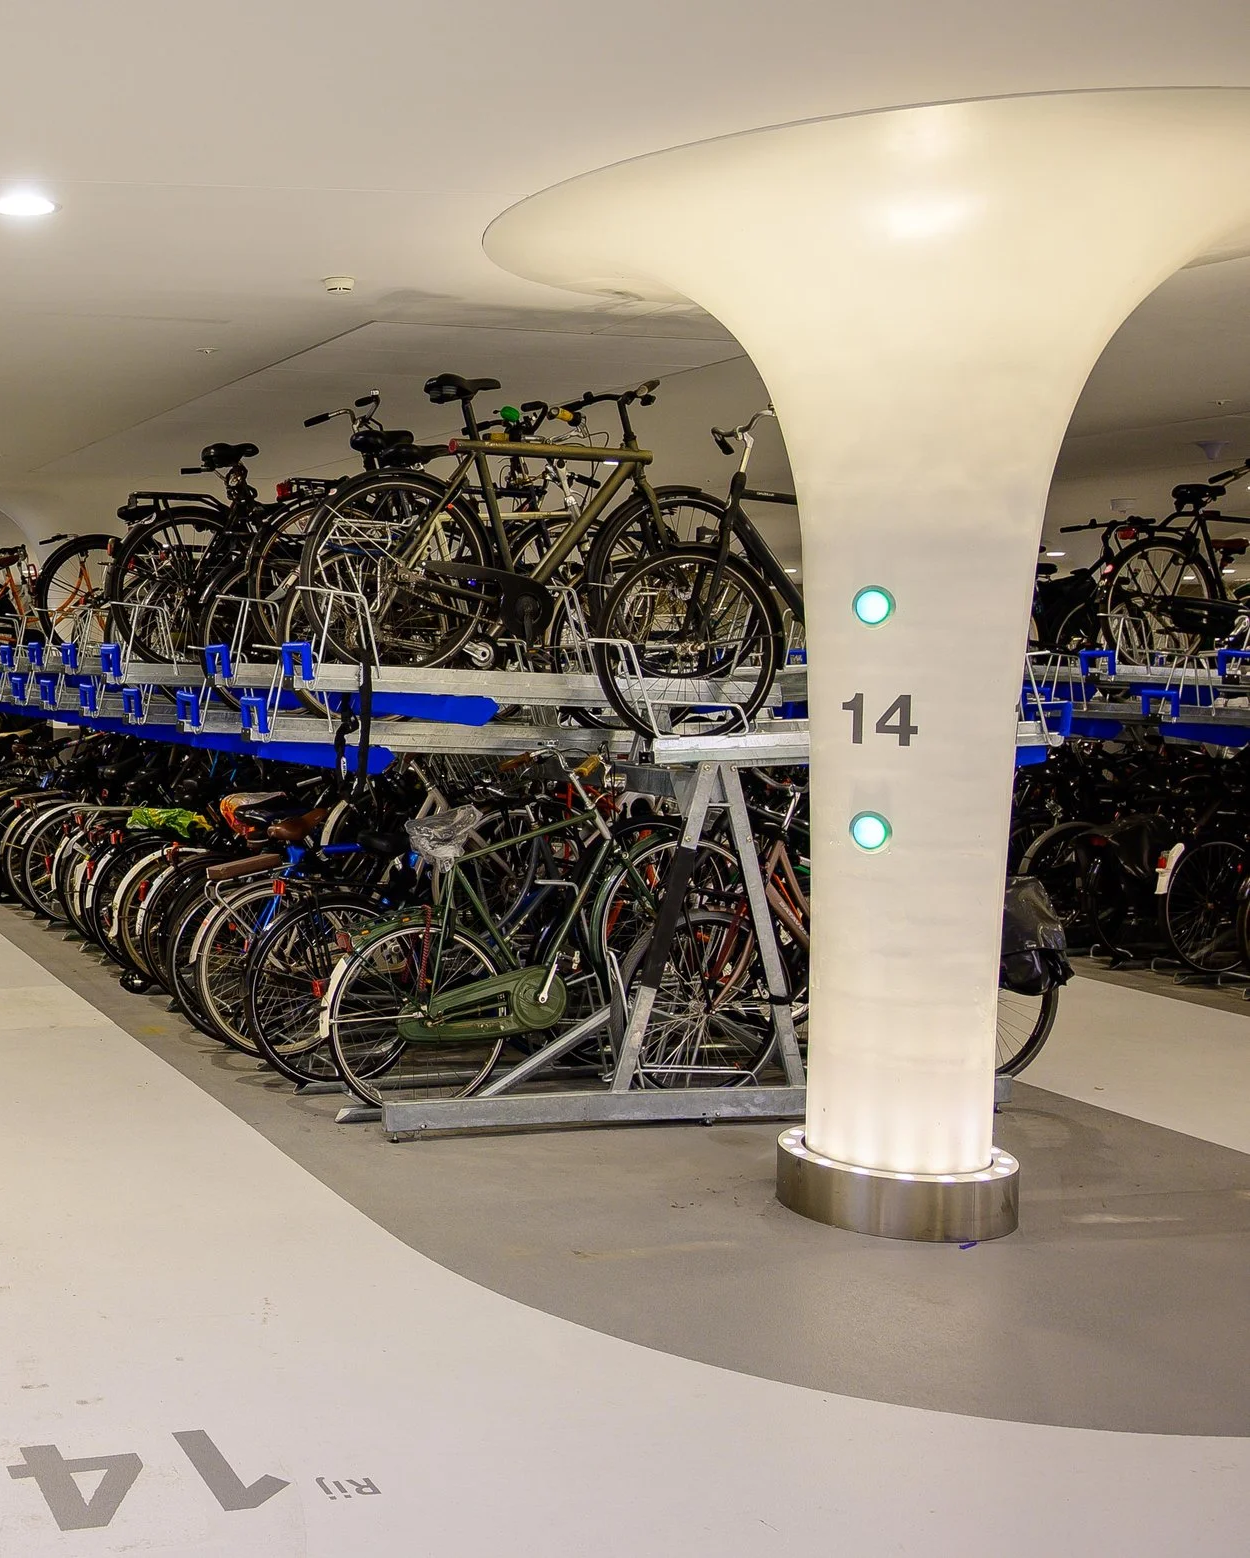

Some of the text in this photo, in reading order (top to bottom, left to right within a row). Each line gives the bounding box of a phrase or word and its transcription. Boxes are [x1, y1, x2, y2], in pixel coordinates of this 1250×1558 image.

[842, 693, 918, 746] 14
[7, 1430, 382, 1531] Rij 14
